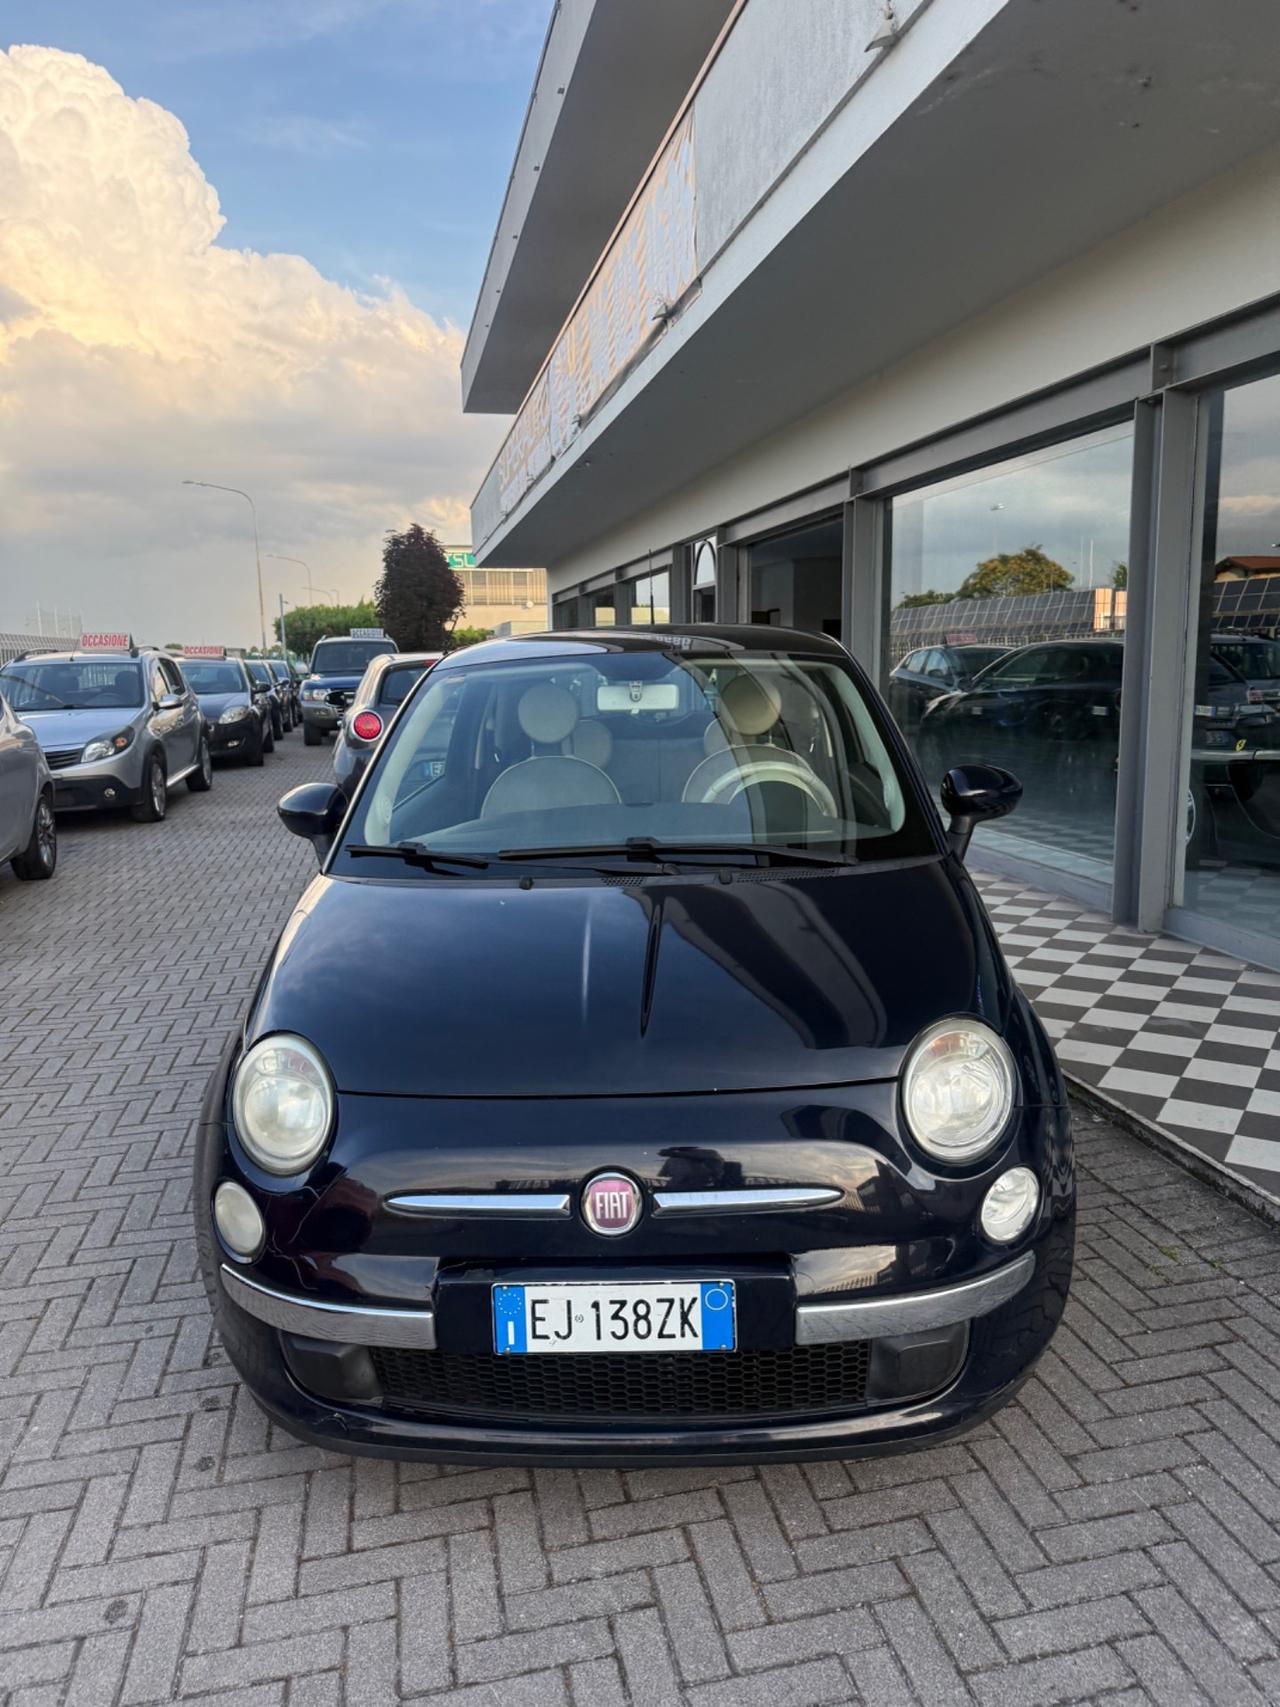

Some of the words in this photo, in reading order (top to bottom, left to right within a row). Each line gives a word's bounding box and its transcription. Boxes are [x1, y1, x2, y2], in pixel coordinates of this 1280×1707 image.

[81, 633, 129, 648] OCCASIONE
[184, 645, 224, 656] OCCASIONE
[595, 1191, 630, 1219] FIAT
